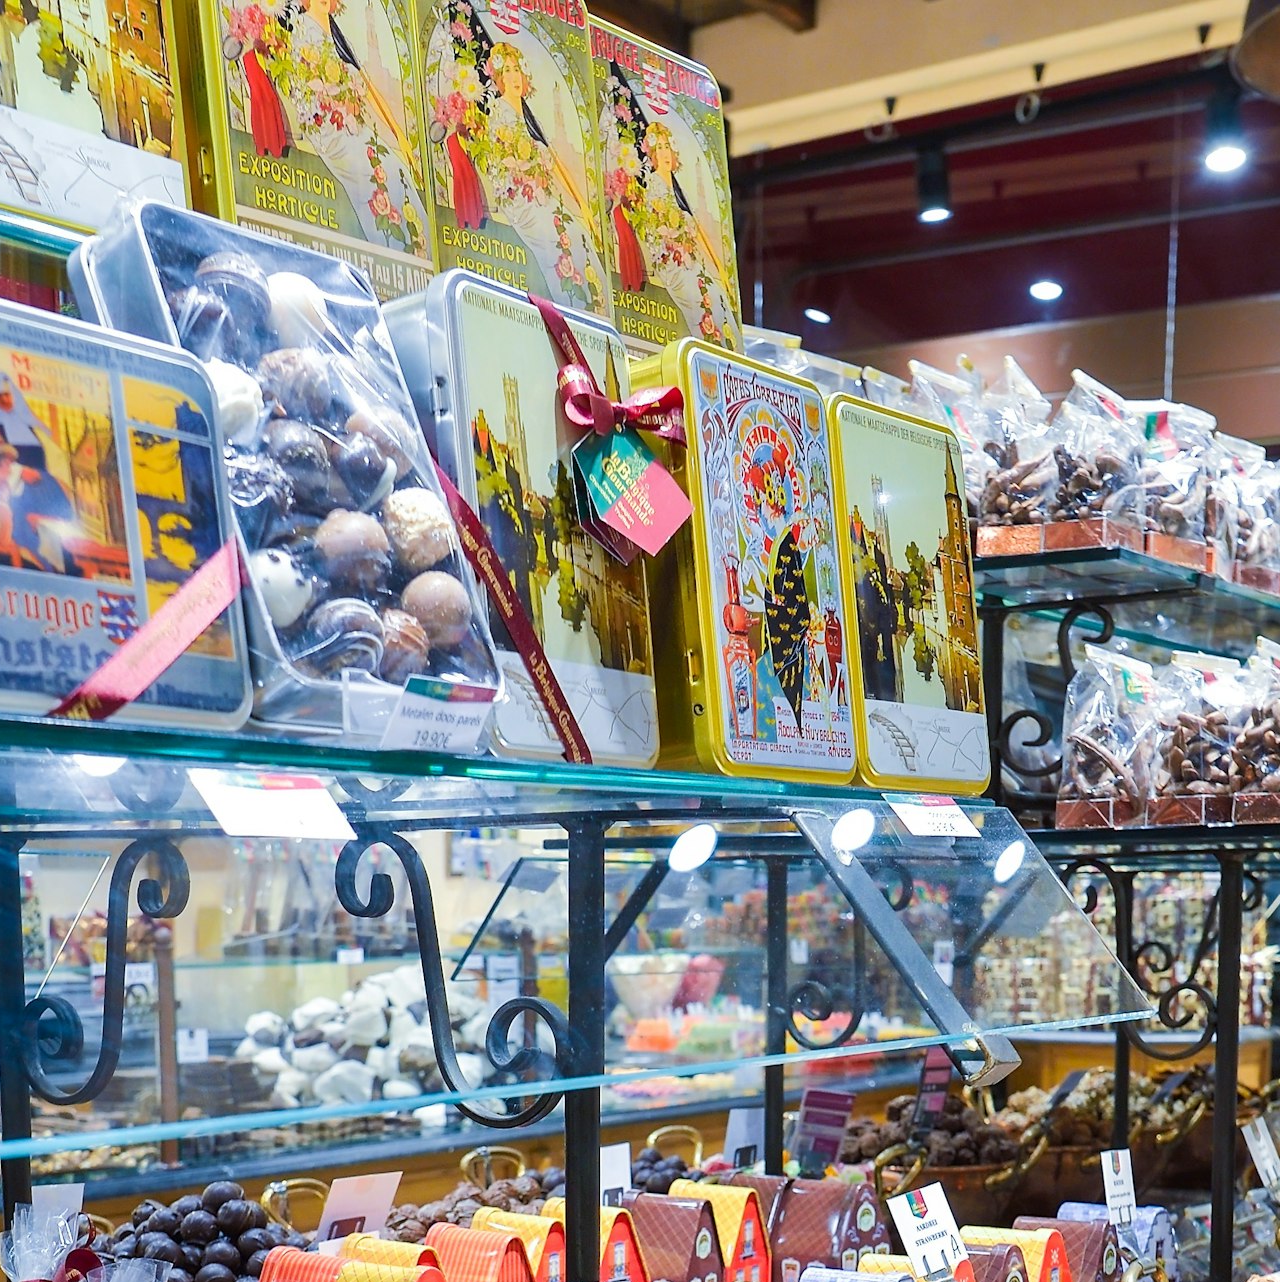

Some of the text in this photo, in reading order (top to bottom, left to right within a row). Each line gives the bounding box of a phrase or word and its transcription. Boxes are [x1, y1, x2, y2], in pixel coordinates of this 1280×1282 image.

[665, 59, 720, 110] BRUGES
[239, 152, 336, 200] EXPOSITION
[255, 185, 339, 230] HORTICOLE
[443, 226, 528, 267] EXPOSITION
[376, 265, 390, 284] AU
[392, 262, 404, 290] 15
[456, 255, 529, 292] HORTICOLE
[463, 290, 498, 316] NATIONALE
[612, 288, 678, 324] EXPOSITION
[621, 315, 678, 345] HORTICOLE
[602, 457, 655, 526] Gourmande
[610, 450, 655, 516] la Belgique
[476, 545, 515, 620] Gourmande
[528, 651, 538, 666] la
[533, 659, 561, 714] Belgique
[400, 705, 482, 728] Metalen doos parels
[412, 730, 453, 749] 19.90€
[950, 1233, 961, 1259] A
